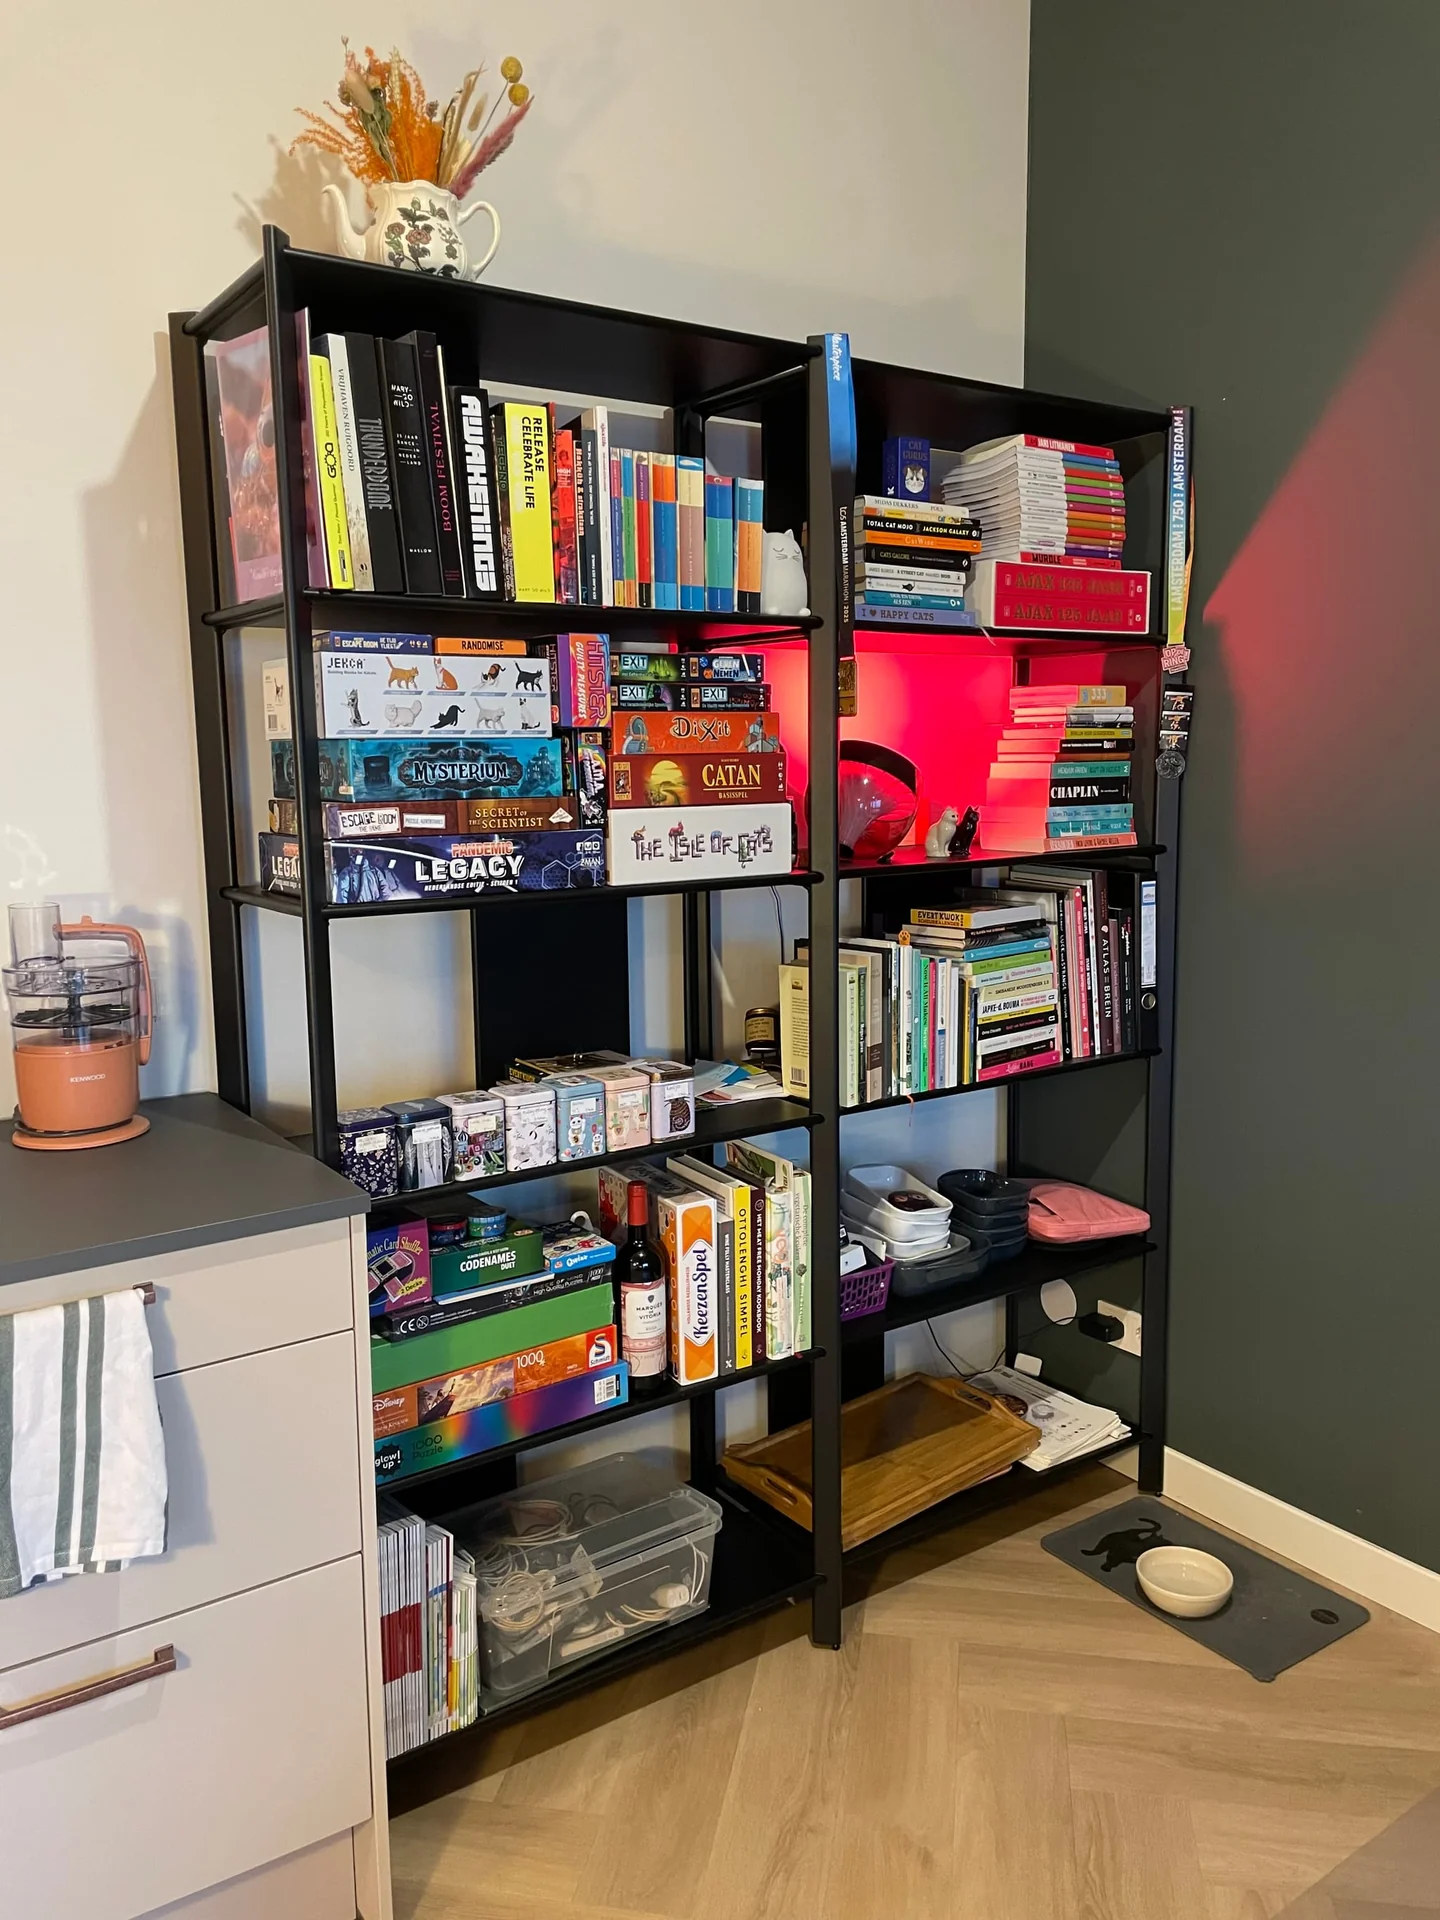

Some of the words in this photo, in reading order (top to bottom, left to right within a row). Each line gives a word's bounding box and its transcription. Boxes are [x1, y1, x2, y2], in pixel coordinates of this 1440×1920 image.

[339, 369, 350, 420] VRIJHAVEN
[344, 420, 355, 472] RUIGOORD
[430, 402, 448, 479] FESTIVAL
[522, 417, 534, 480] CELEBRATE
[533, 418, 544, 472] RELEASE
[909, 441, 922, 450] CAT
[1172, 416, 1184, 490] AMSTERDAM
[359, 418, 392, 511] THUNDERDOME
[498, 436, 507, 492] TECHNO
[461, 395, 497, 592] AWAKENINGS
[526, 481, 535, 509] LIFE
[442, 486, 452, 531] BOOM
[893, 501, 918, 509] DEKKERS
[1172, 499, 1183, 522] 750
[867, 520, 884, 528] TOTAL
[840, 521, 849, 565] AMSTERDAM
[1032, 554, 1061, 564] MURDLE
[1172, 531, 1183, 602] AMSTERDAM
[1016, 572, 1054, 590] AJAX
[881, 610, 909, 619] HAPPY
[913, 612, 934, 621] CATS
[1014, 604, 1053, 620] AJAX
[1086, 609, 1122, 623] JAAR
[342, 640, 362, 648] ESCAPE
[363, 641, 378, 649] ROOM
[462, 640, 504, 651] RANDOMISE
[327, 658, 363, 669] JEKCA
[576, 642, 586, 672] GUILTY
[622, 656, 647, 669] EXIT
[550, 644, 558, 693] HITSTER
[713, 670, 740, 678] NEMEN
[588, 641, 606, 720] HITSTER
[577, 672, 587, 719] PLEASURES
[622, 687, 646, 700] EXIT
[704, 689, 726, 701] EXIT
[413, 761, 510, 784] MYSTERIUM
[702, 764, 761, 786] CATAN
[1051, 786, 1099, 799] CHAPLIN
[341, 812, 376, 828] ESCAPE
[378, 814, 397, 825] ROOM
[475, 807, 518, 819] SECRET
[482, 816, 544, 829] SCIENTIST
[1083, 822, 1101, 831] Houd
[452, 841, 514, 858] PANDEMIC
[631, 836, 664, 861] THE
[669, 832, 706, 862] ISLE
[711, 831, 733, 854] OF
[416, 855, 524, 883] LEGACY
[425, 882, 464, 892] NEDERLANDSE
[918, 911, 938, 919] EVERT
[939, 912, 960, 922] KWOK
[1102, 938, 1110, 976] ATLAS
[1017, 982, 1043, 991] WOORDENBOEK
[1003, 1000, 1020, 1010] BOUMA
[1104, 985, 1112, 1019] BREIN
[70, 1073, 106, 1083] KENWOOD
[794, 1193, 802, 1235] vegetarische
[803, 1205, 808, 1214] De
[384, 1236, 400, 1251] Card
[401, 1236, 423, 1256] Shuffler
[739, 1209, 747, 1289] OTTOLENGHI
[460, 1251, 516, 1272] CODENAMES
[501, 1262, 516, 1271] DUET
[590, 1268, 604, 1278] 1000
[405, 1280, 423, 1292] Decks
[534, 1288, 545, 1297] High
[546, 1284, 565, 1295] Quality
[565, 1279, 584, 1288] Puzzles
[693, 1249, 712, 1340] KeezenSpel
[639, 1312, 661, 1320] VITORIA
[740, 1294, 748, 1338] SIMPEL
[400, 1318, 416, 1333] CE
[516, 1350, 544, 1368] 1000
[590, 1356, 610, 1366] Schmidt
[373, 1398, 405, 1412] Disney
[412, 1434, 442, 1450] 1000
[375, 1450, 401, 1468] glow!
[412, 1446, 443, 1459] Puzzle
[382, 1462, 394, 1470] up
